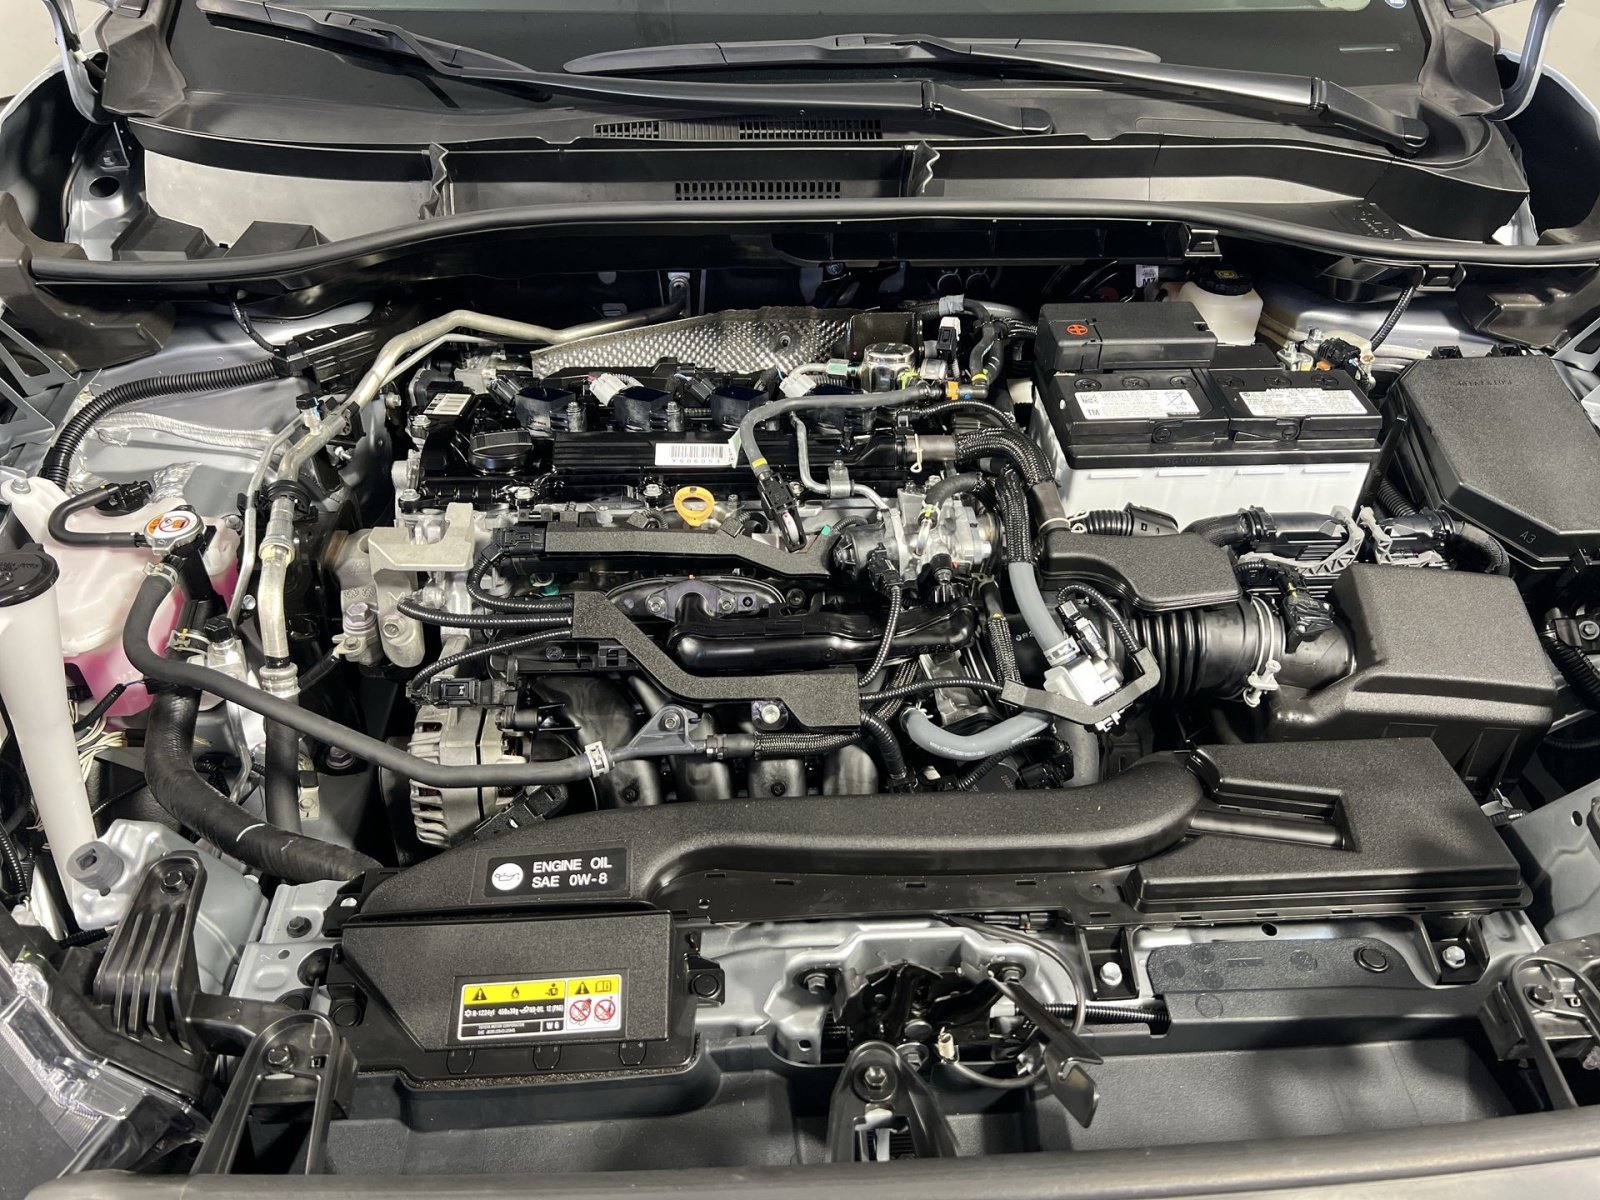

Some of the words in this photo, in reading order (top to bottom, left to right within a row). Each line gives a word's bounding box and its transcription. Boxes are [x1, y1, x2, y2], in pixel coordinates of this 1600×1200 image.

[1520, 530, 1537, 544] A3
[532, 858, 582, 873] ENGINE
[590, 856, 613, 869] OIL
[531, 875, 560, 888] SAE
[569, 872, 608, 886] 0W-8
